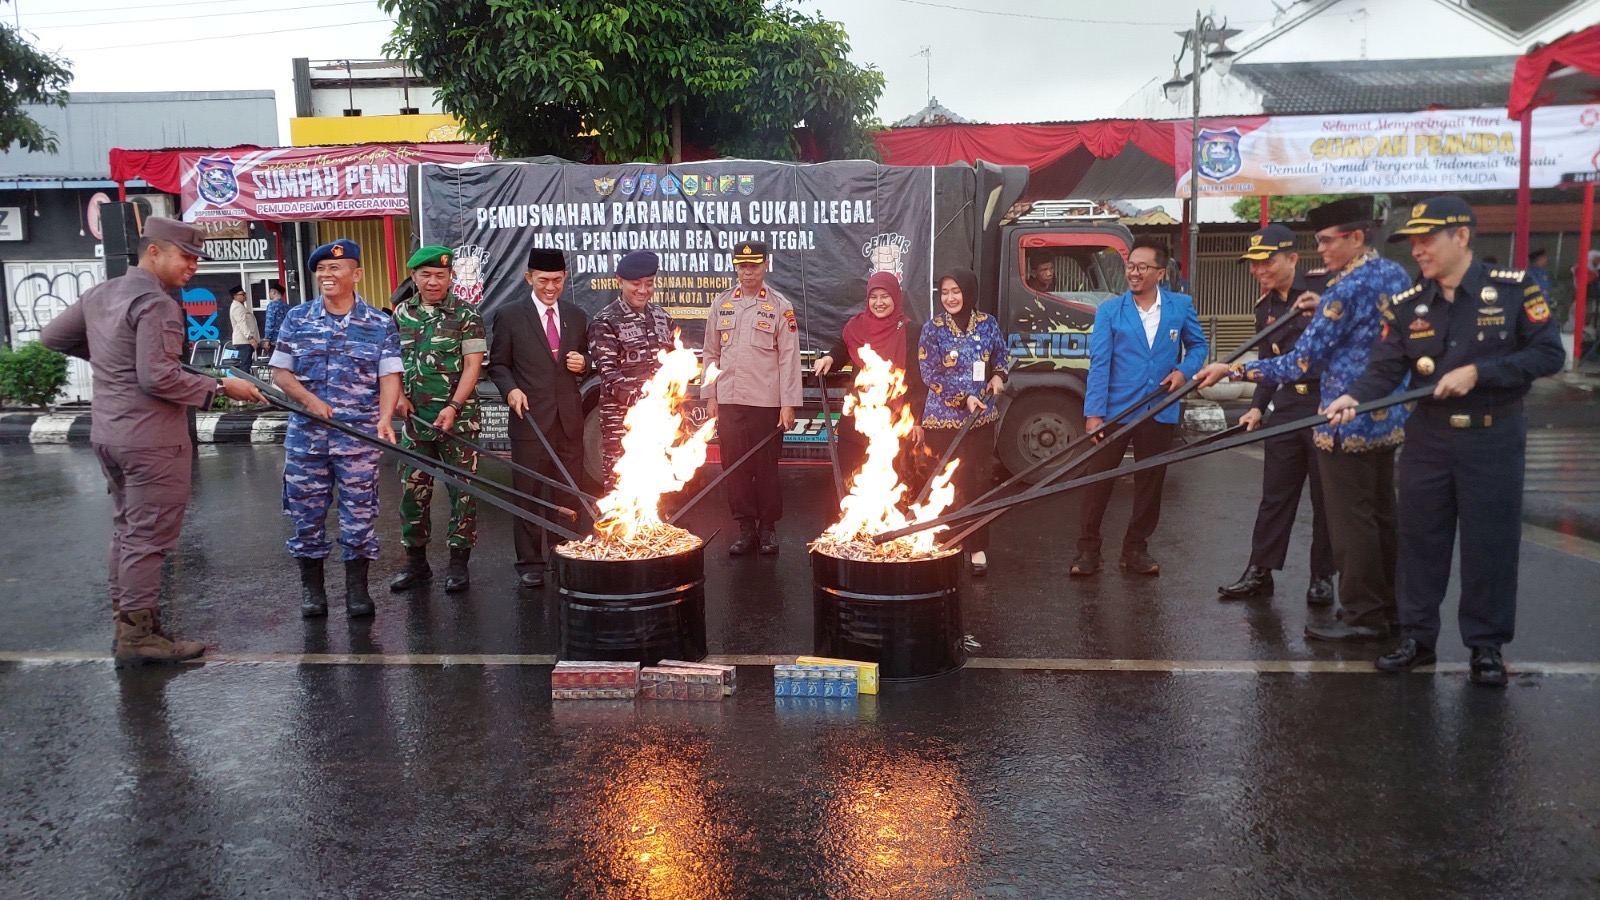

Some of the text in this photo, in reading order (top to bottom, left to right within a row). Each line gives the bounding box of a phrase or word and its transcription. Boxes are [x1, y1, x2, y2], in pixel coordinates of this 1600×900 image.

[1321, 115, 1500, 132] Selamat Memperingati Hari
[1310, 131, 1515, 160] SUMPAH PEMUDA
[259, 158, 311, 171] Selamat
[314, 148, 391, 168] Memperingati
[1322, 159, 1369, 173] Pemudi
[1372, 159, 1431, 176] Bergerak
[1433, 157, 1498, 170] Indonesia
[252, 164, 408, 199] SUMPAH PEMU
[1320, 173, 1497, 187] 97 TAHUN SUMPAH PEMUDA
[257, 202, 297, 214] PEMUDA
[300, 201, 335, 213] PEMUDI
[338, 198, 388, 211] BERGERAK
[476, 199, 875, 230] PEMUSNAHAN BARANG KENA CUKAI ILEGAL
[534, 229, 816, 251] HASIL PENINDAKAN BEA CUKAI TEGAL
[862, 233, 911, 257] GEMPUR
[453, 245, 490, 264] EMPUR
[576, 254, 608, 274] DAN
[697, 277, 733, 289] DBHCHT
[679, 292, 703, 303] KOTA
[757, 311, 776, 320] POLRI
